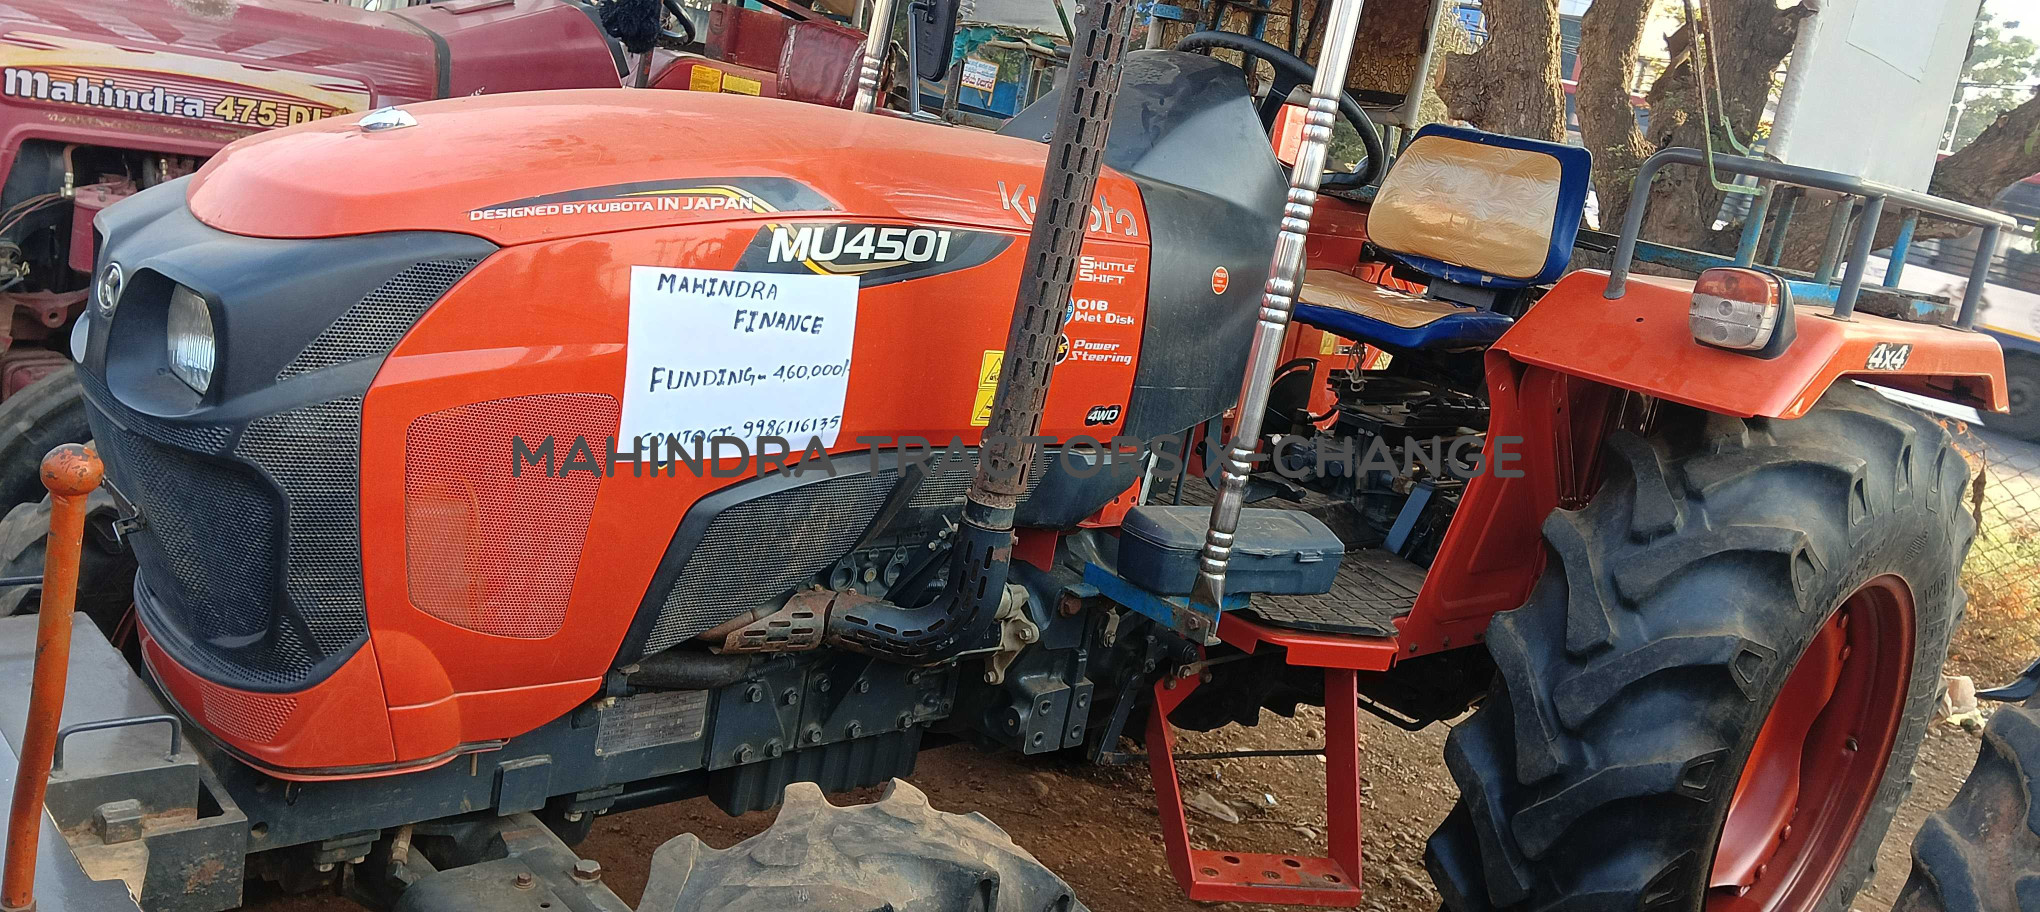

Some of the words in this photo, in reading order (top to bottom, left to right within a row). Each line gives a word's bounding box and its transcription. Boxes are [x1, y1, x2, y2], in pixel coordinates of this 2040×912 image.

[4, 67, 206, 117] Mahindra
[213, 96, 278, 127] 475
[469, 205, 560, 221] DESIGNED
[562, 203, 584, 215] BY
[587, 201, 654, 214] KUBOTA
[657, 197, 680, 212] IN
[682, 196, 755, 211] JAPAN
[767, 226, 951, 264] MU4501
[1079, 256, 1136, 274] SHUTTLE
[1078, 269, 1126, 285] SHIFT
[656, 273, 778, 301] MAHINDRA
[1076, 298, 1109, 312] OIB
[732, 309, 824, 335] FINANCE
[1075, 311, 1102, 324] Wet
[1105, 312, 1135, 326] Disk
[1073, 339, 1120, 352] Power
[1068, 350, 1132, 366] Steering
[1867, 343, 1909, 370] 4x4
[1087, 406, 1119, 422] 4WD
